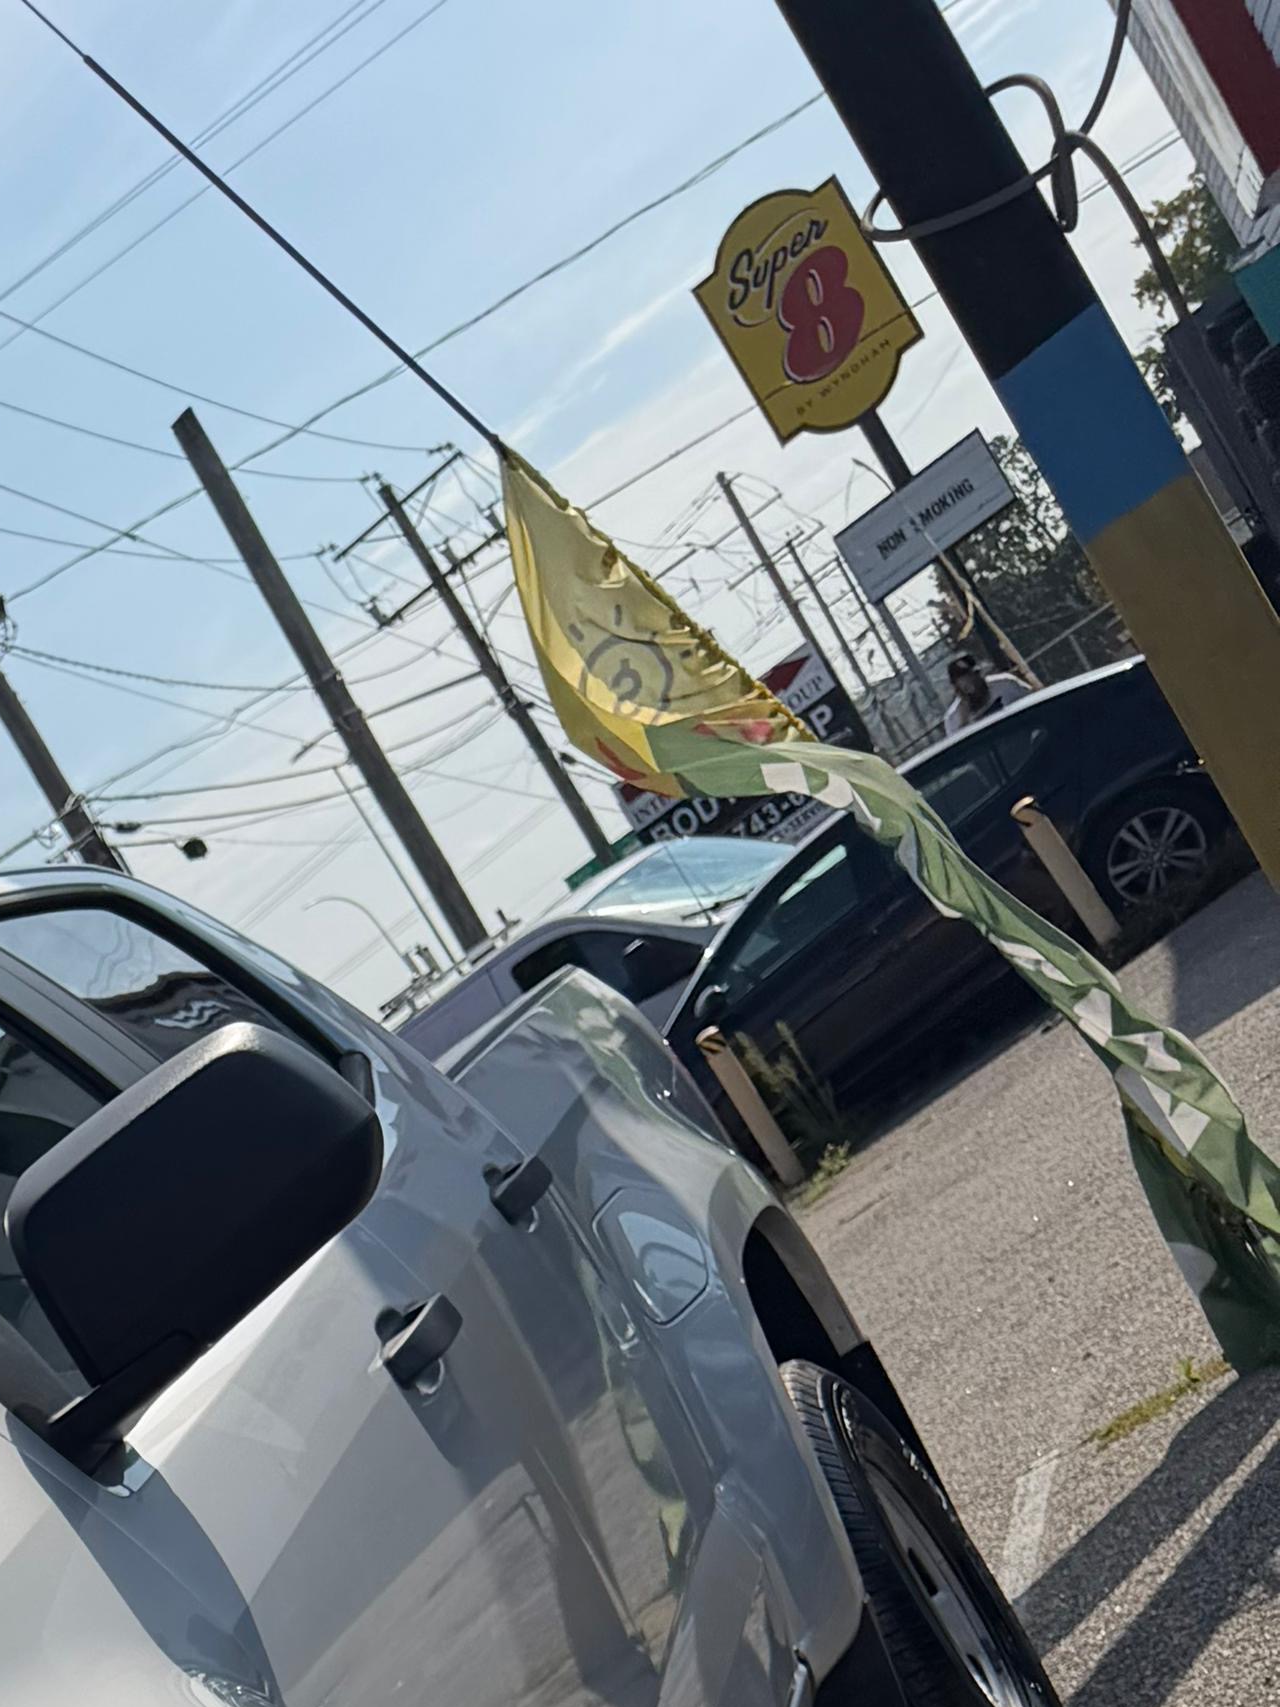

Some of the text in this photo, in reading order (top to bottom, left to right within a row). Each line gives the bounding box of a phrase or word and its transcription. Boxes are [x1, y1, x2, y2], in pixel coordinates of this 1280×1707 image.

[728, 218, 829, 310] Super
[779, 245, 866, 384] 8
[796, 339, 892, 416] BY WYNDHAM
[876, 528, 908, 560] NON
[651, 796, 737, 841] BOD
